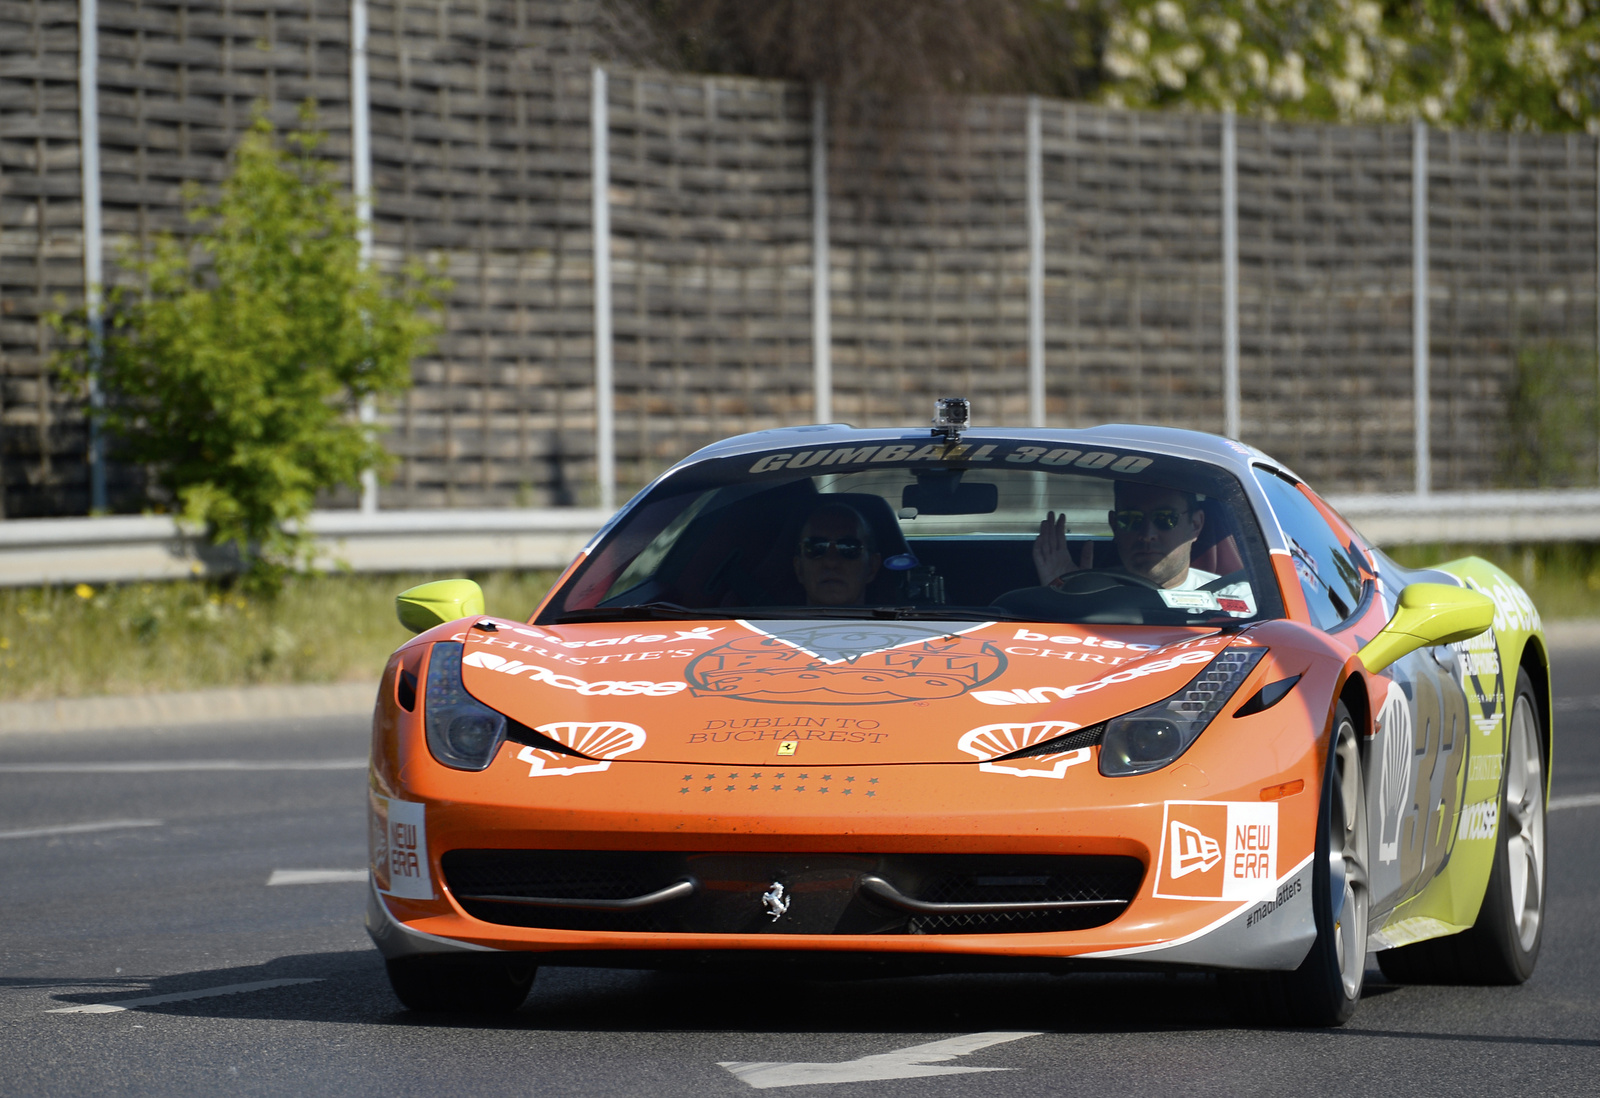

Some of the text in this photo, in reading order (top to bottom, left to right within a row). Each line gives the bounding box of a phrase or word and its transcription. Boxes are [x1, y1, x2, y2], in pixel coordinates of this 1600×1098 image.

[749, 444, 1154, 473] GUMBALL 3000
[450, 632, 696, 666] CHRISTIE'S
[1005, 634, 1255, 667] CHRIIE'S
[1013, 629, 1161, 651] betsa
[493, 659, 688, 696] incase
[1012, 650, 1215, 704] incase
[686, 729, 889, 744] BUCHAREST
[703, 716, 880, 730] DUBLIN TO
[391, 822, 417, 850] NEW
[1235, 824, 1271, 851] NEW
[392, 849, 420, 878] ERA
[1233, 852, 1269, 879] ERA
